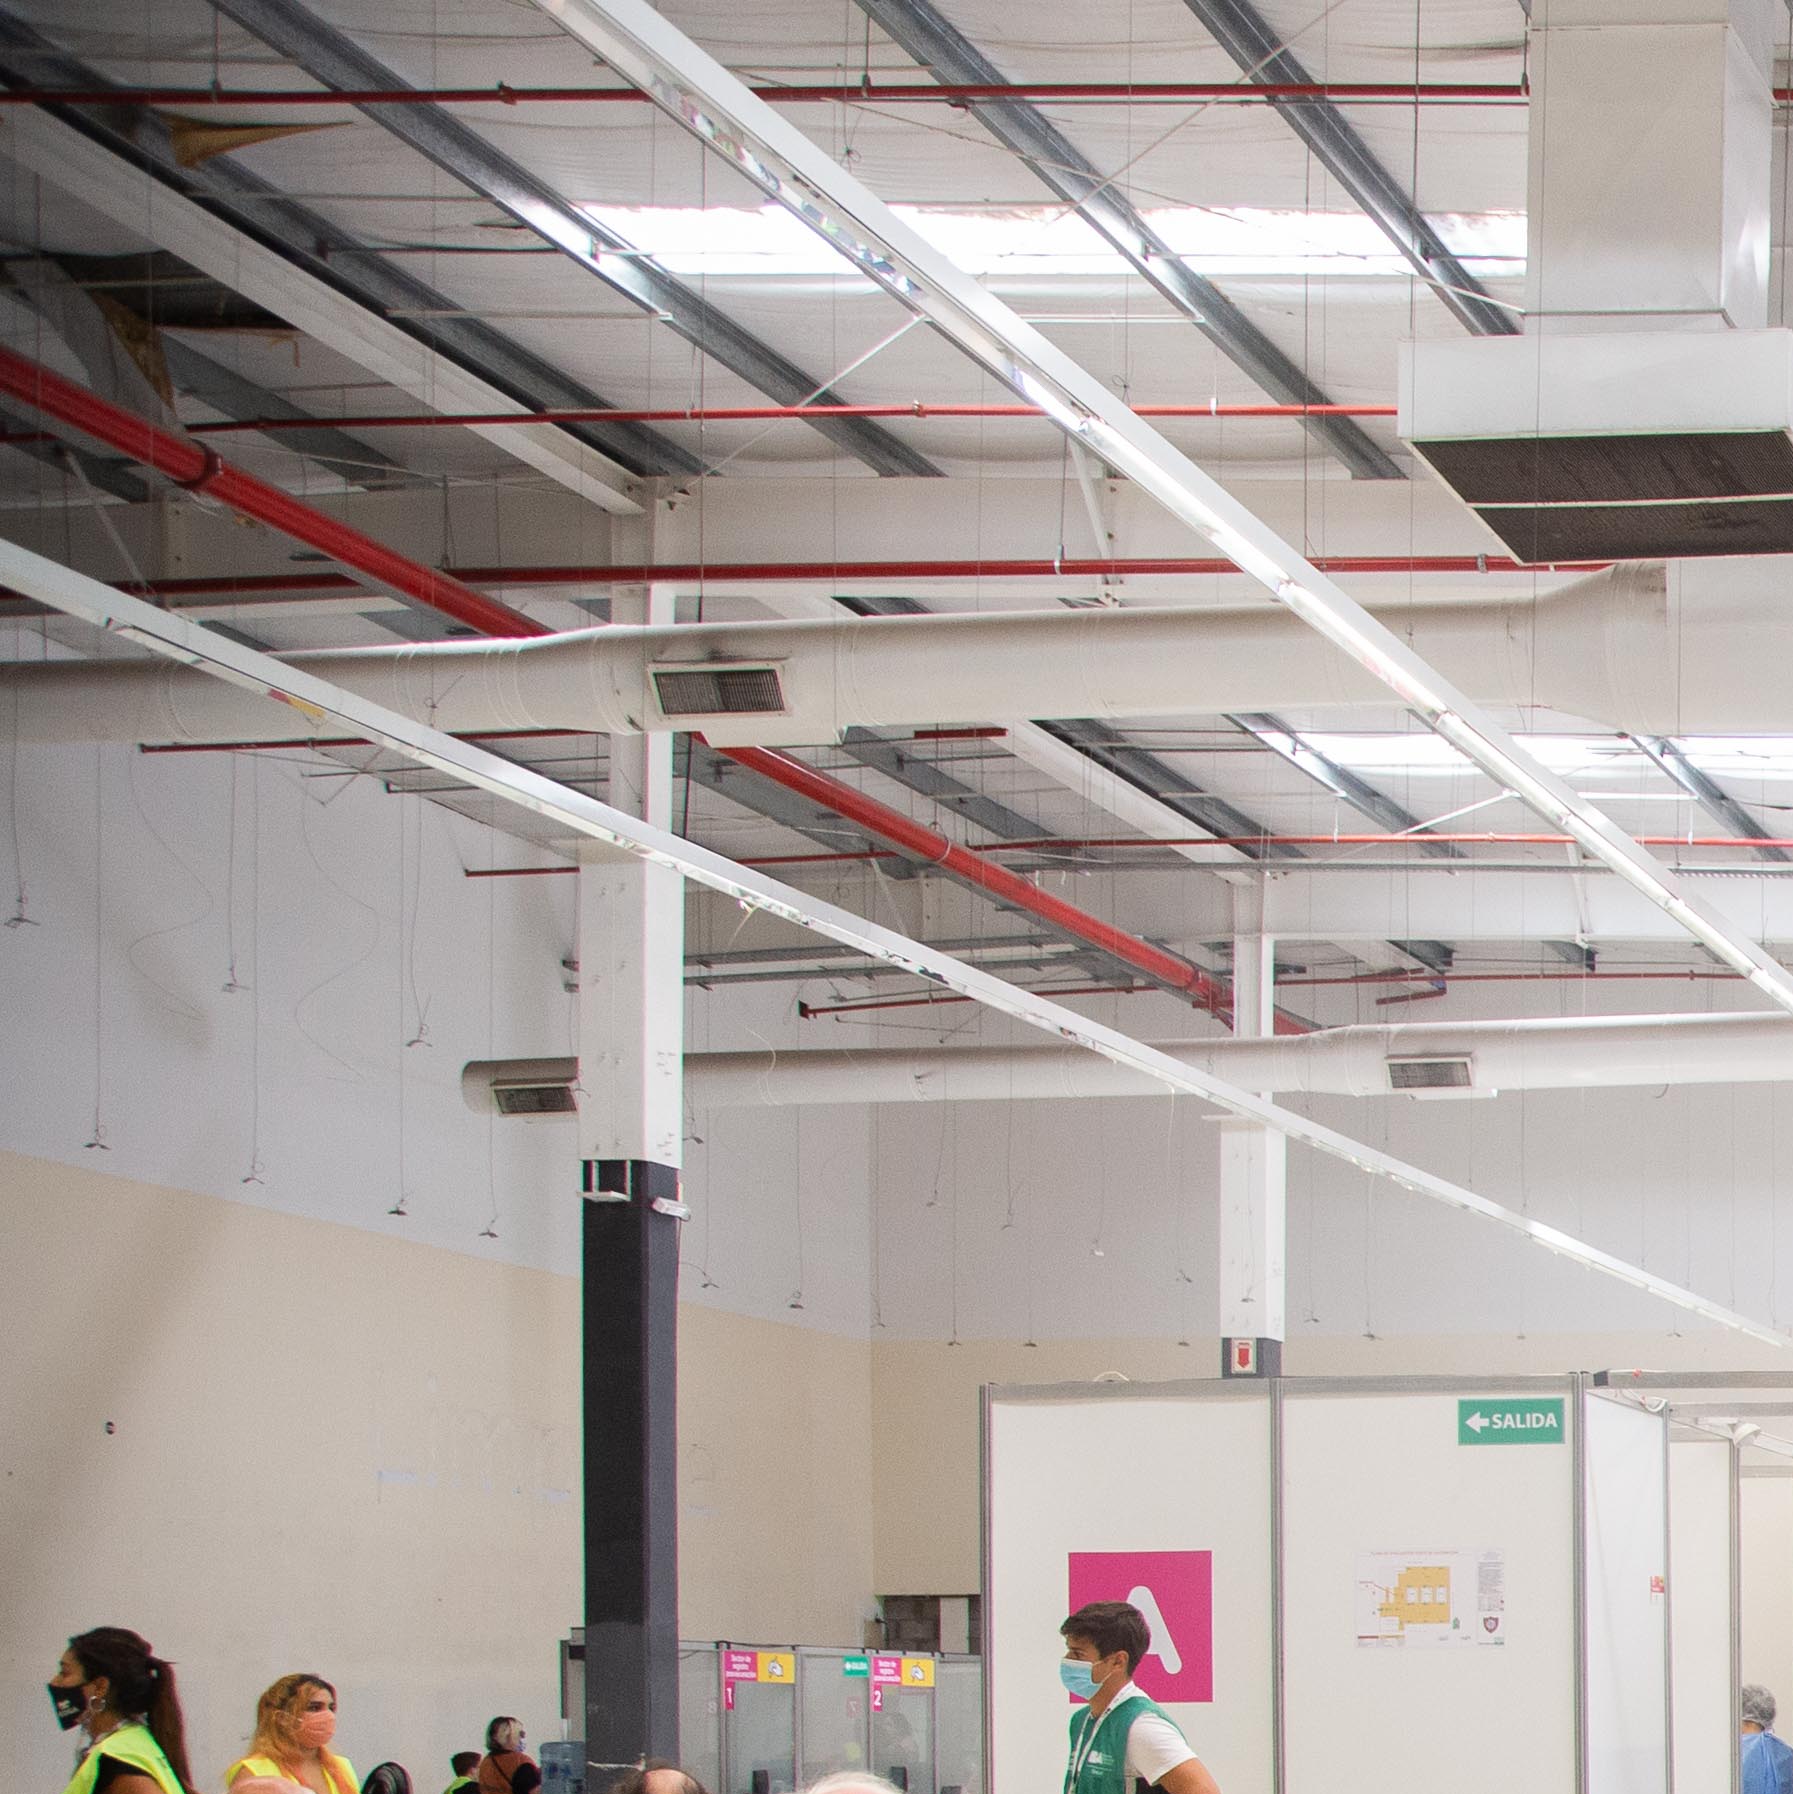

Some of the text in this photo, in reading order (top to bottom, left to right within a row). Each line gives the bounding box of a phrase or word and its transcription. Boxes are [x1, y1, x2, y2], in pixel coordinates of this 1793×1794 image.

[1492, 1413, 1558, 1429] SALIDA
[1126, 1586, 1182, 1675] A
[727, 1688, 733, 1703] 1
[874, 1690, 882, 1706] 2
